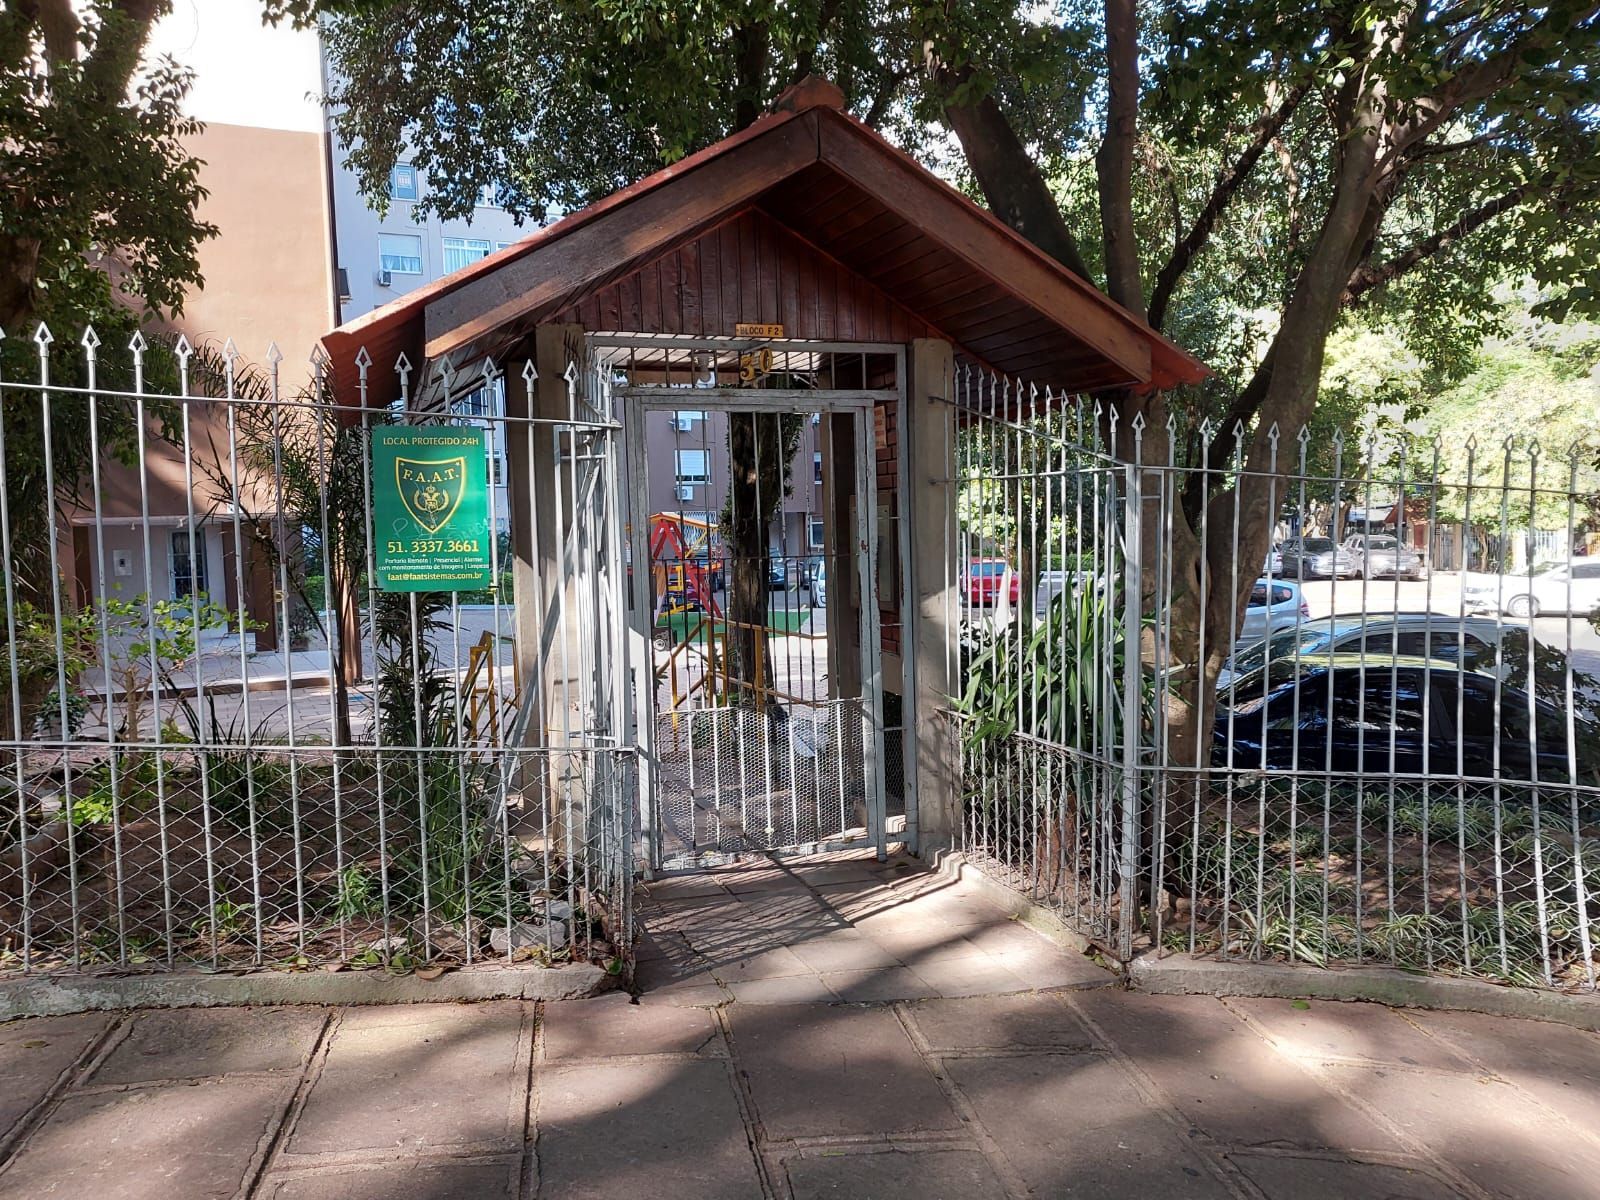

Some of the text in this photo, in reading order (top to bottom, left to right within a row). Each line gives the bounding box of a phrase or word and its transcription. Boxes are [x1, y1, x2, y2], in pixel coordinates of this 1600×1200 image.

[740, 326, 779, 336] BLOCO F 2
[383, 437, 479, 446] LOCAL PROTEGIDO 24H
[402, 468, 460, 483] F.A.A.T.
[387, 540, 479, 553] 51. 3337.3661
[387, 571, 483, 581] faat@faatsistemas.com.br
